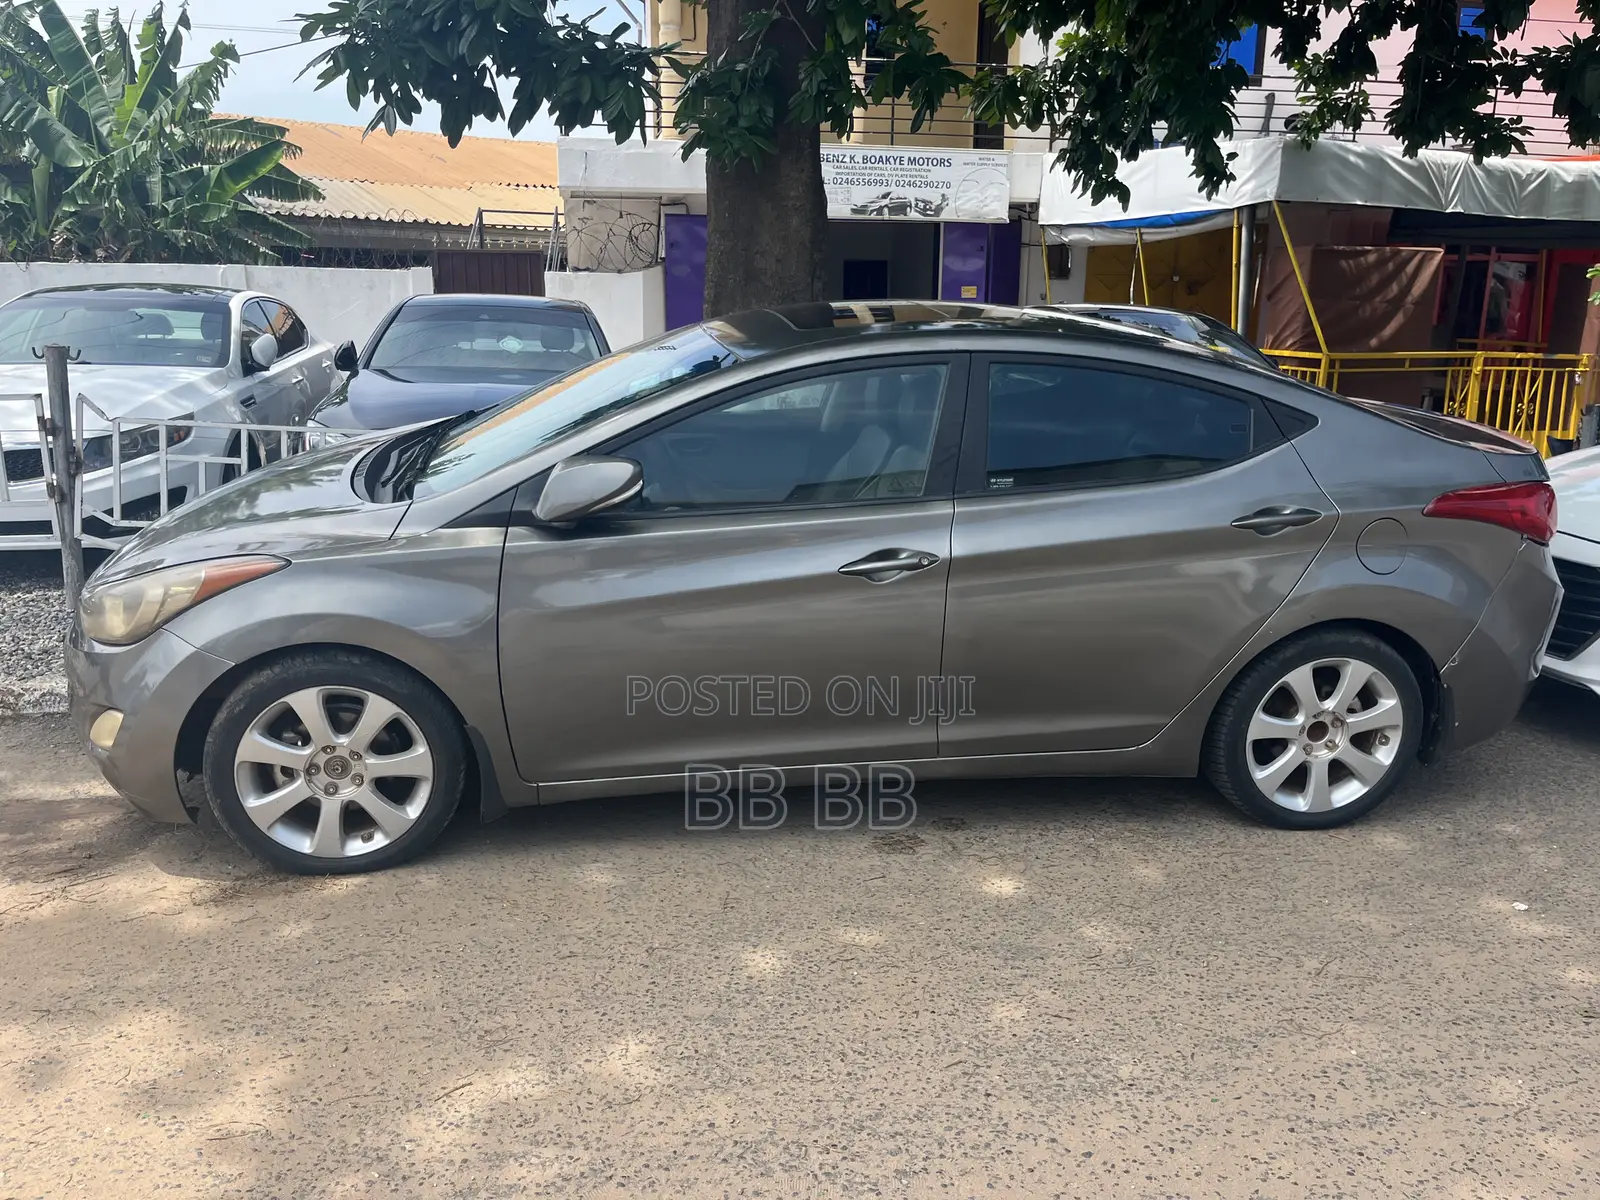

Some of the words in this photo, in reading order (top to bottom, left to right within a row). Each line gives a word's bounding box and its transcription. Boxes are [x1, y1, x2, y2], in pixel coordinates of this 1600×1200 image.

[820, 153, 846, 163] BENZ
[849, 154, 860, 164] K.
[862, 154, 905, 165] BOAKYE
[907, 156, 952, 168] MOTORS
[895, 179, 951, 189] 0246290270
